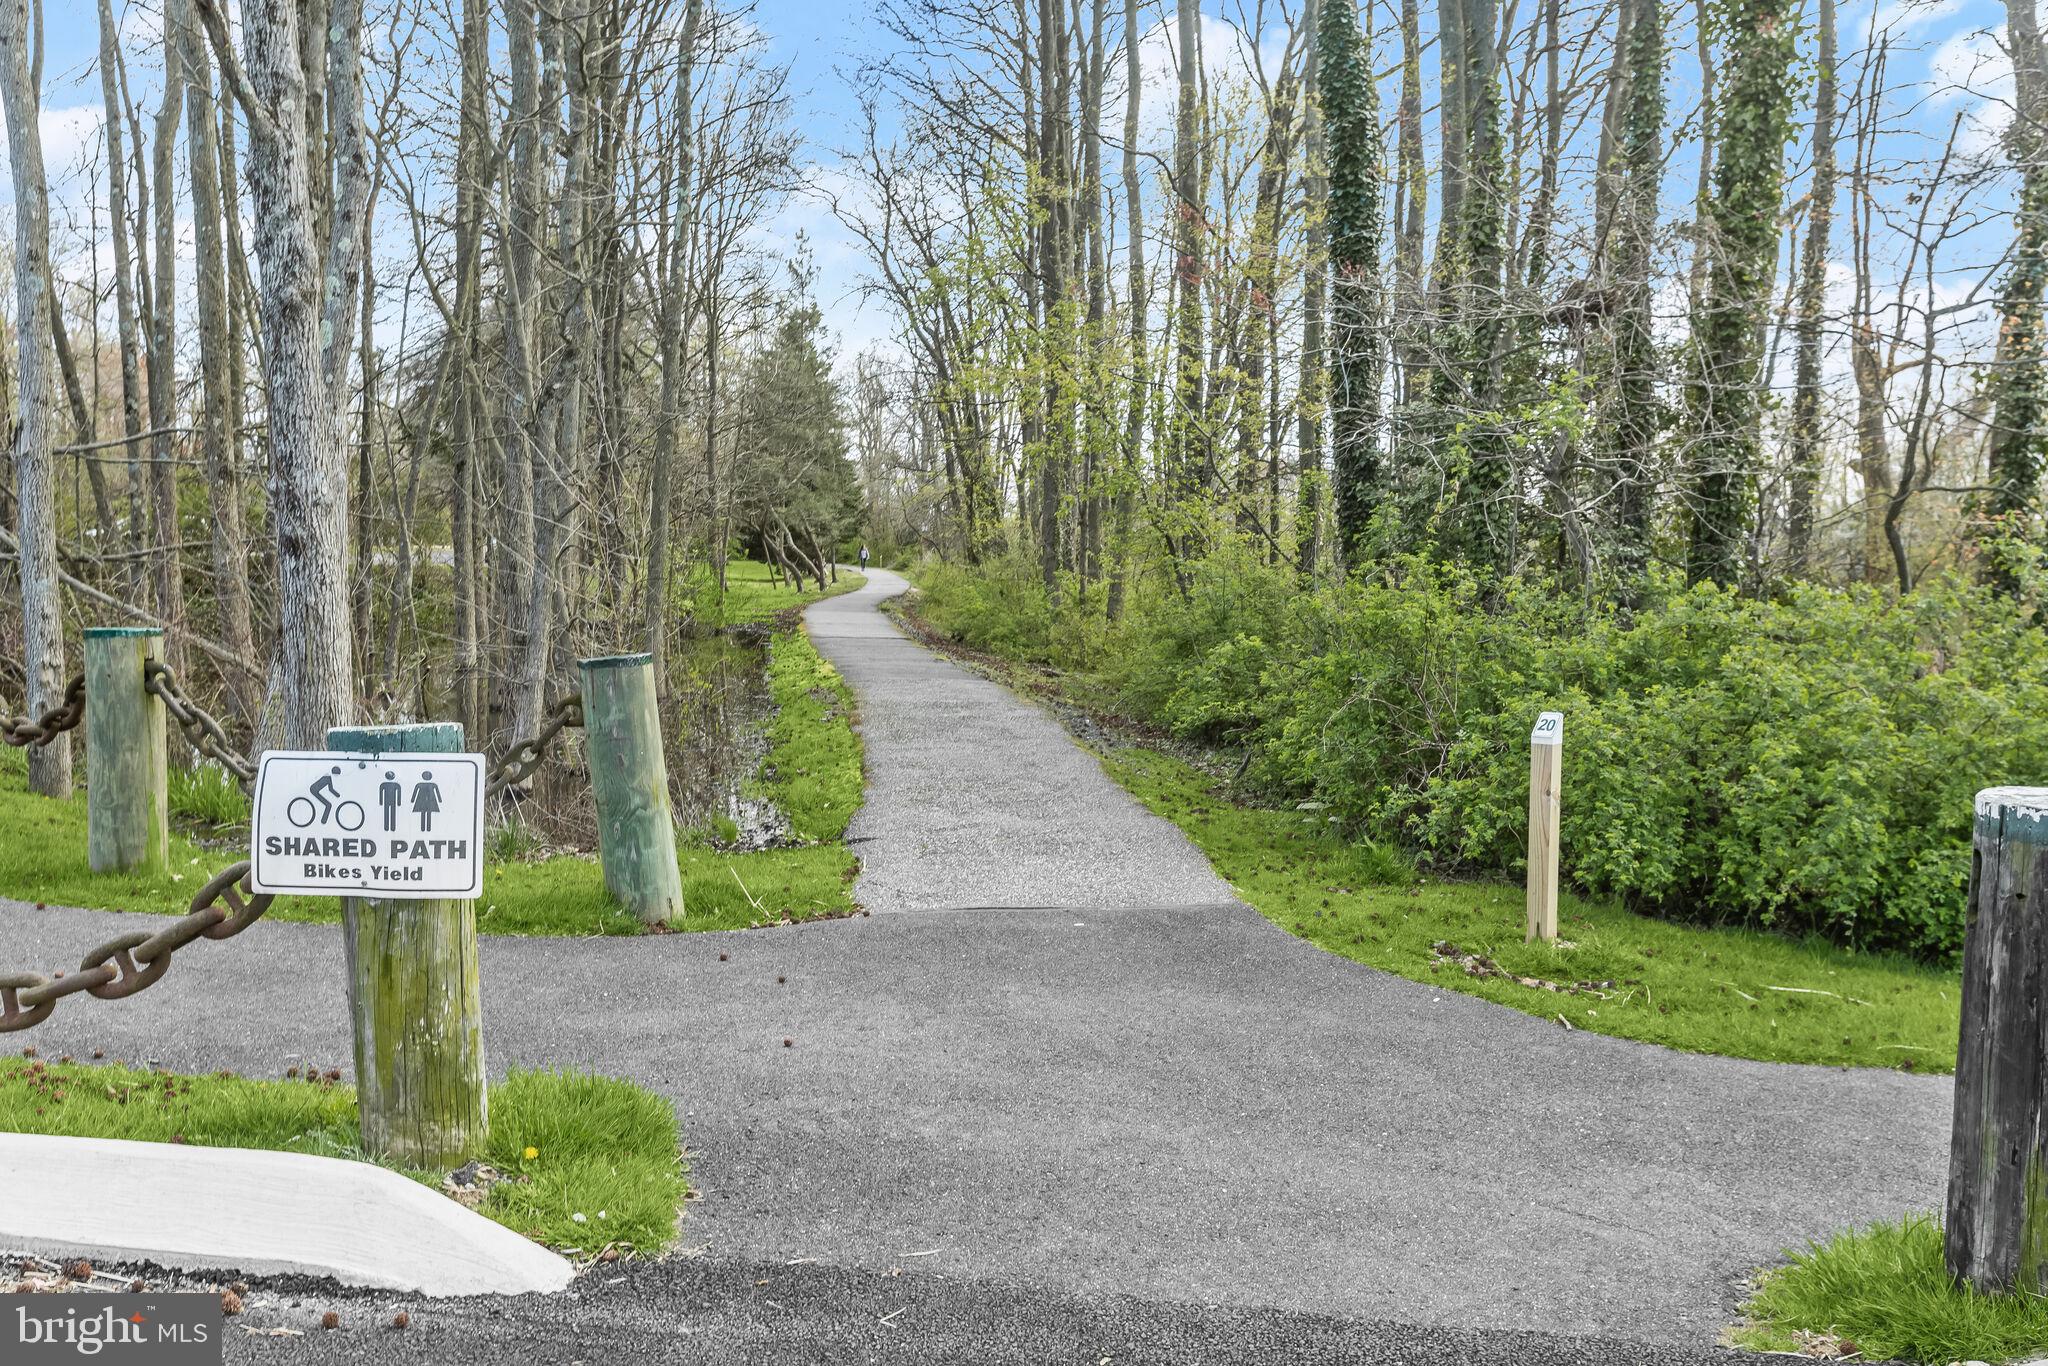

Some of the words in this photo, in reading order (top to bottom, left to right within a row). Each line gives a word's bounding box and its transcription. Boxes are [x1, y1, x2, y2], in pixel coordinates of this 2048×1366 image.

[1537, 719, 1556, 731] 20
[265, 836, 377, 858] SHARED
[390, 839, 467, 859] PATH
[304, 863, 362, 879] Bikes
[370, 865, 423, 881] Yield
